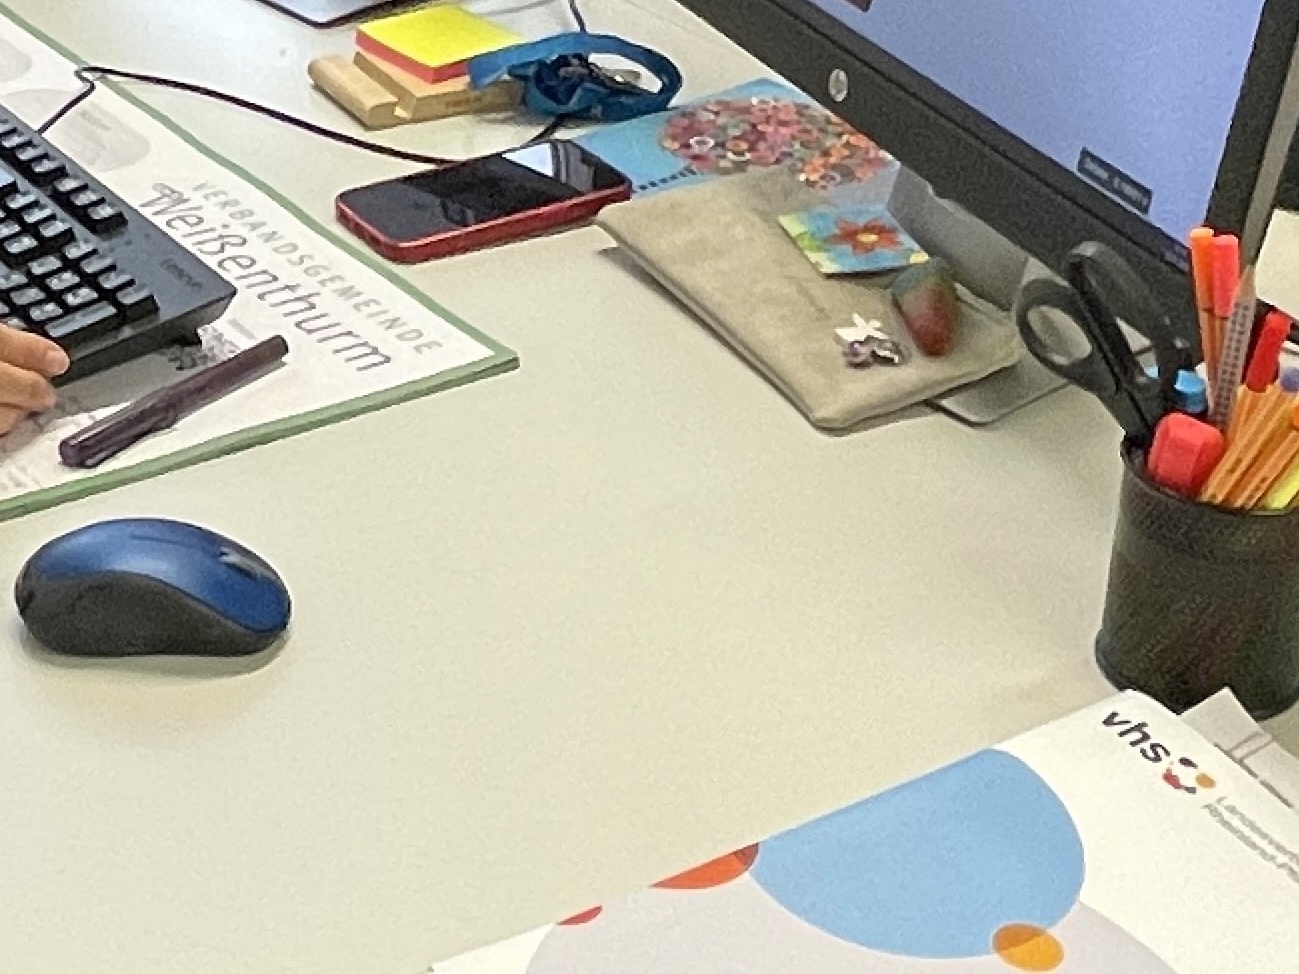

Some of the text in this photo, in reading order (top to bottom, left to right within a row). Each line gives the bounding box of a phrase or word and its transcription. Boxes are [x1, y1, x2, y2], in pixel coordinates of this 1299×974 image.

[139, 182, 392, 372] Weißenthurm
[192, 181, 444, 355] VERBANDSGEMEINDE
[1101, 710, 1171, 764] vhs
